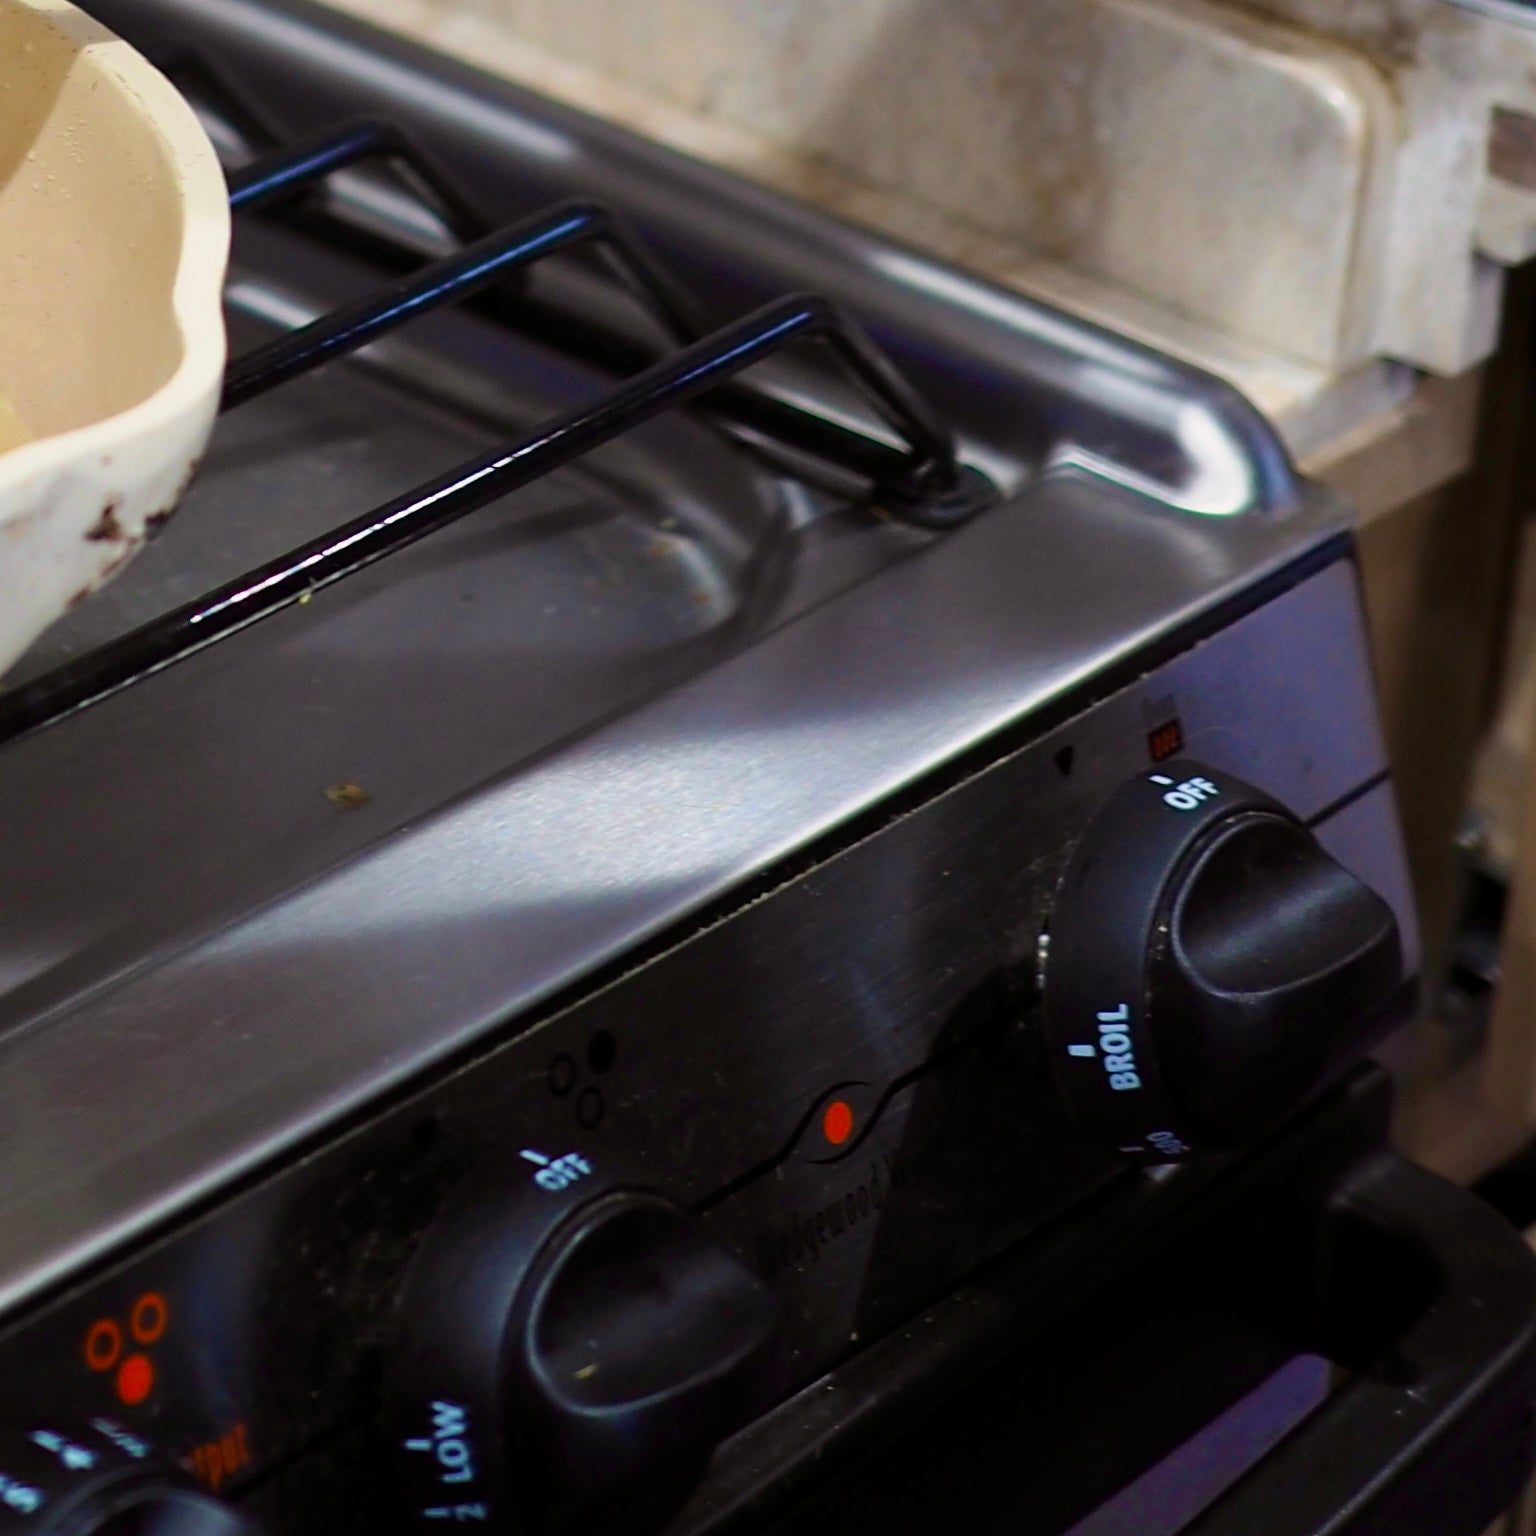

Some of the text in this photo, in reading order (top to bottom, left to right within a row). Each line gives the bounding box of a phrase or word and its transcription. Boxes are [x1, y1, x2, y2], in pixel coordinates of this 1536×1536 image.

[1163, 776, 1221, 811] OFF
[1096, 1003, 1142, 1092] BROIL
[534, 1151, 593, 1191] OFF
[431, 1400, 474, 1483] LOW
